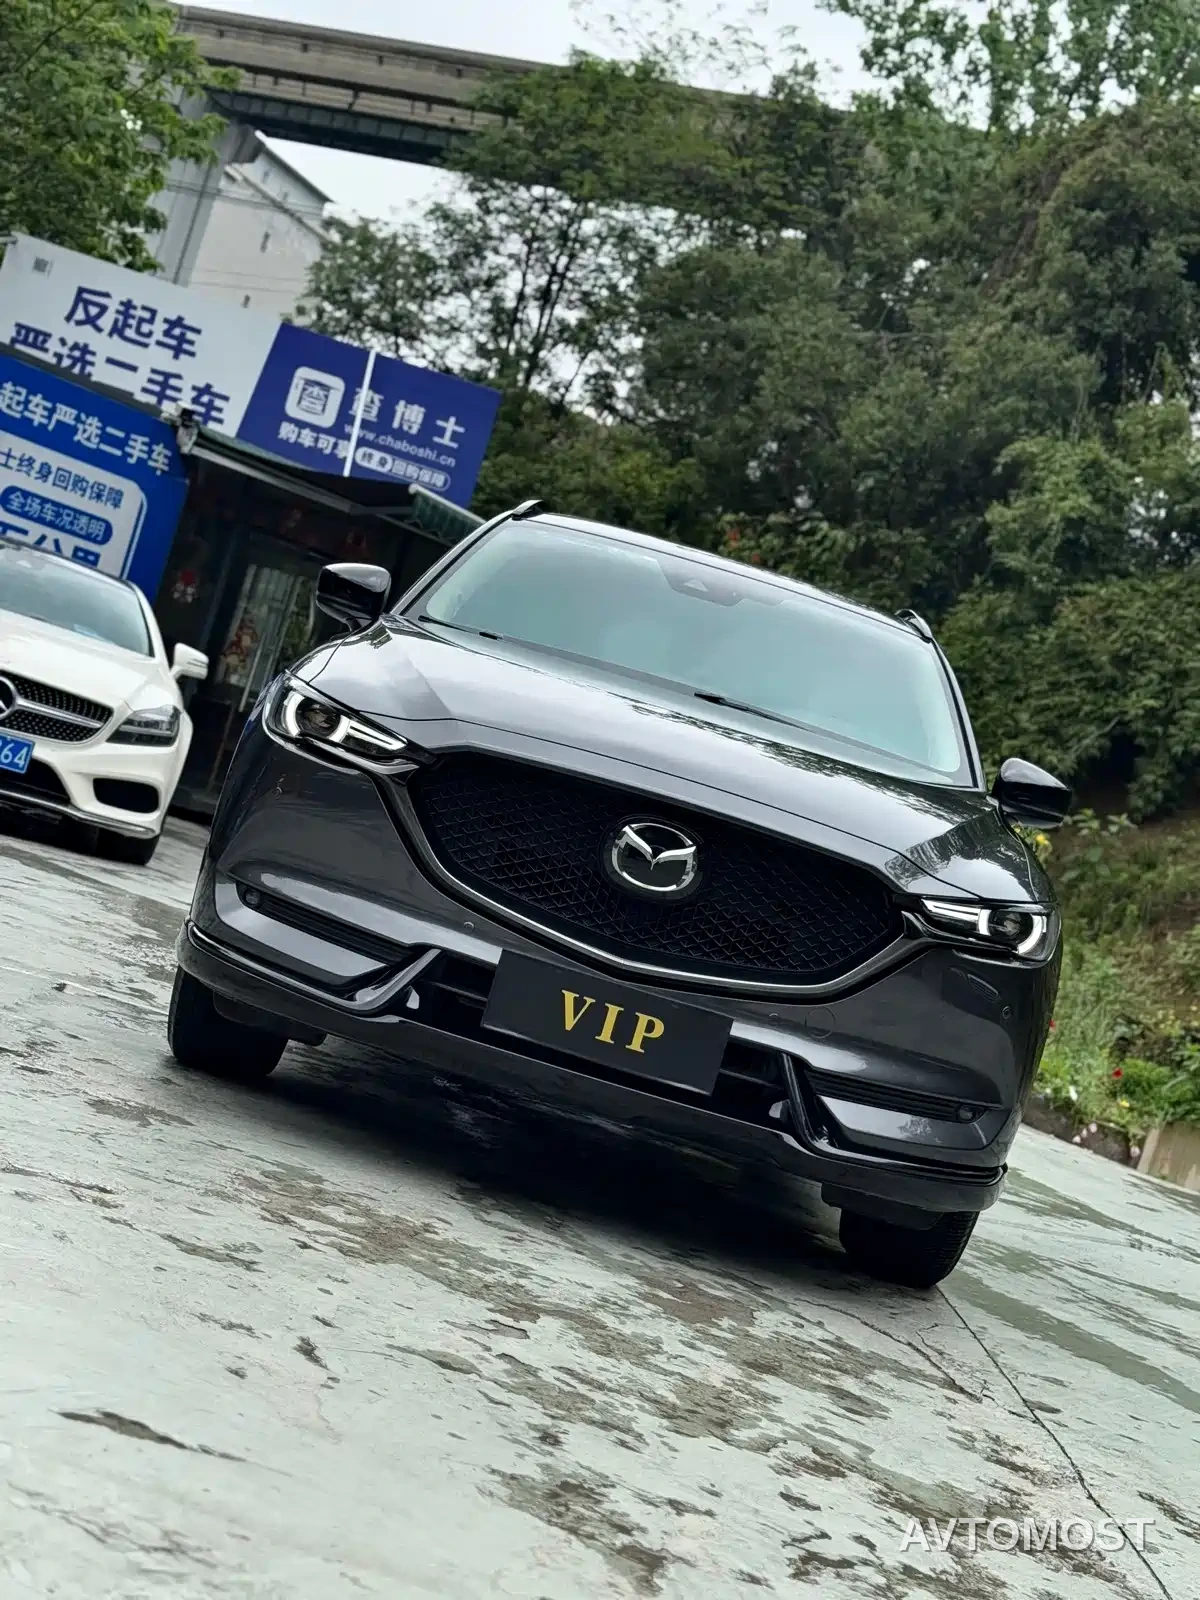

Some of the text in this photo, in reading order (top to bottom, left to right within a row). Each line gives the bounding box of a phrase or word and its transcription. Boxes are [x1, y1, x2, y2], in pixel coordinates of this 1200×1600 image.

[64, 286, 202, 360] 反起车
[0, 381, 172, 476] 起车严选二手车
[348, 387, 466, 449] 查博士
[0, 448, 125, 510] 士终身回购保障
[8, 490, 107, 541] 全场车况透明
[0, 742, 29, 769] 64
[561, 989, 665, 1053] VIP
